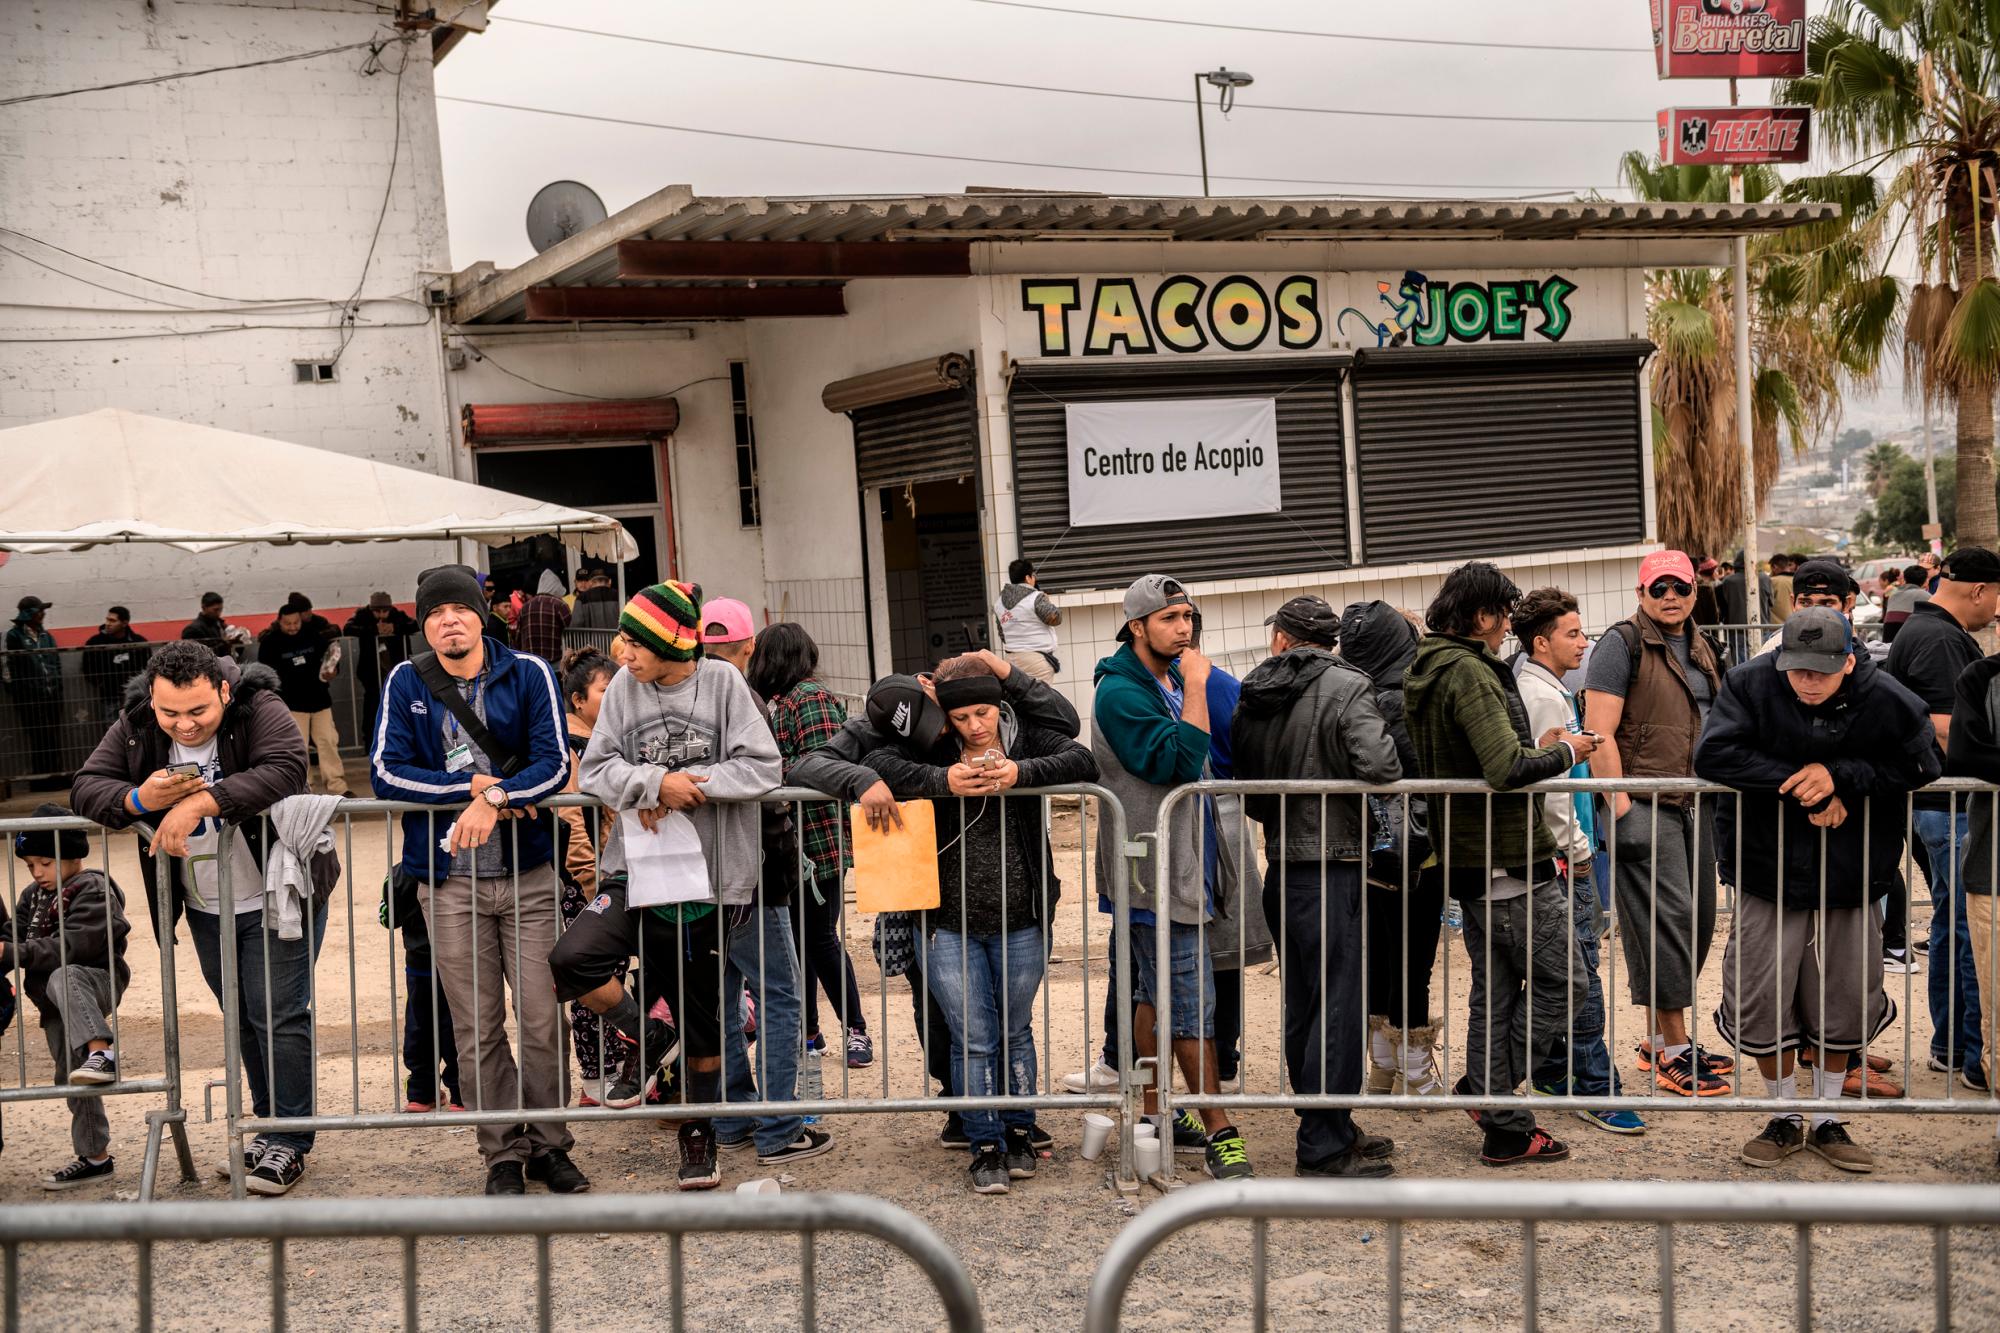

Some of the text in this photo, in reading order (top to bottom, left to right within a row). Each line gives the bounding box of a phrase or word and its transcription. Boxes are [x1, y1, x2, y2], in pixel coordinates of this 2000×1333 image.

[1674, 20, 1802, 51] Barretal
[1702, 14, 1769, 28] BILLARES
[1710, 117, 1803, 152] TECATE
[1021, 275, 1322, 357] TACOS
[1412, 274, 1578, 346] JOE'S
[1084, 439, 1264, 477] Centro de Acopio
[890, 700, 909, 729] NIKE
